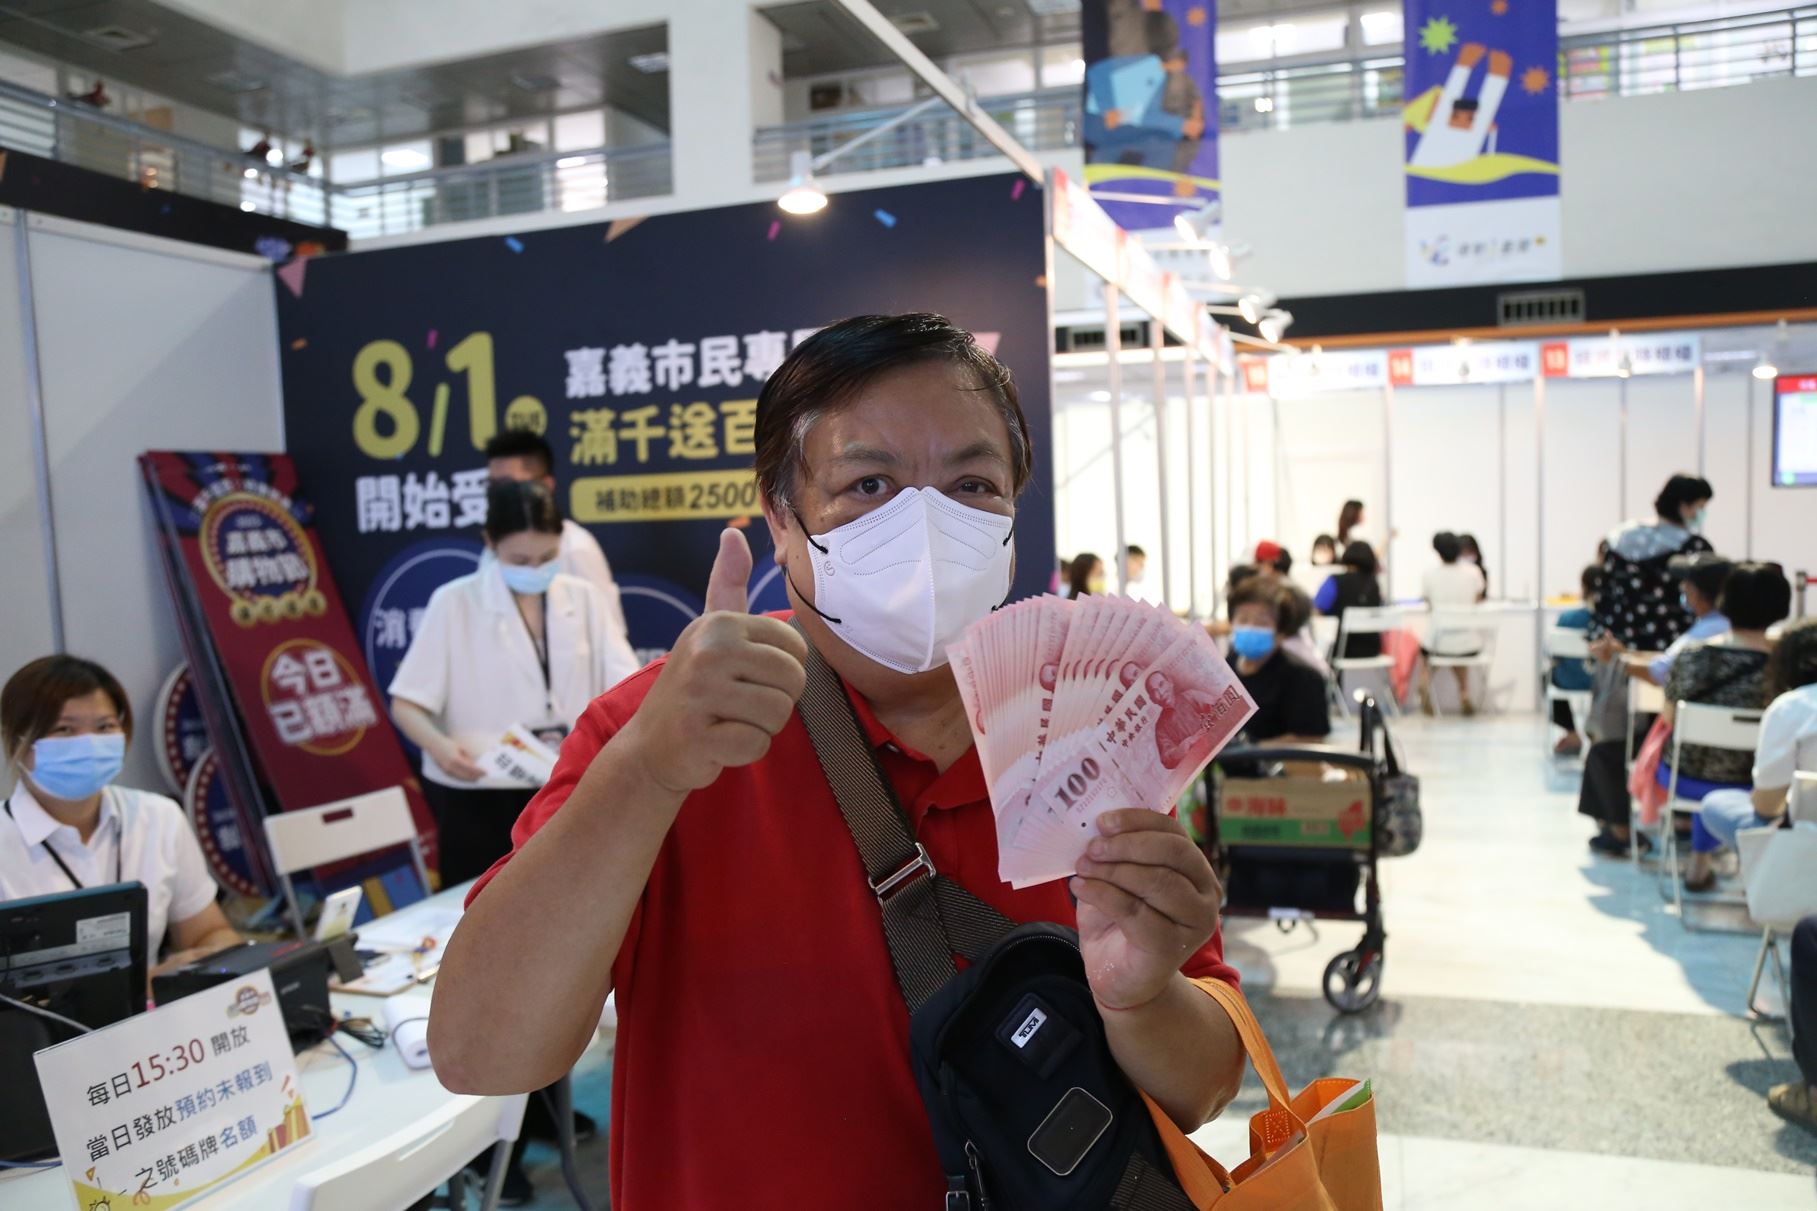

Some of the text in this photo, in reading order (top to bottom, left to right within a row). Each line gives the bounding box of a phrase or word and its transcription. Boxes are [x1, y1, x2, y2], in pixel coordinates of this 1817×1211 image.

[352, 331, 498, 460] 8/1
[564, 327, 808, 399] 嘉義市民專
[355, 468, 490, 534] 開始受
[270, 648, 342, 696] 今日
[1054, 757, 1100, 811] 100
[210, 1024, 252, 1057] 開放
[86, 1060, 274, 1163] 當日發放預約未報到
[134, 1114, 258, 1192] 之號碼牌名額
